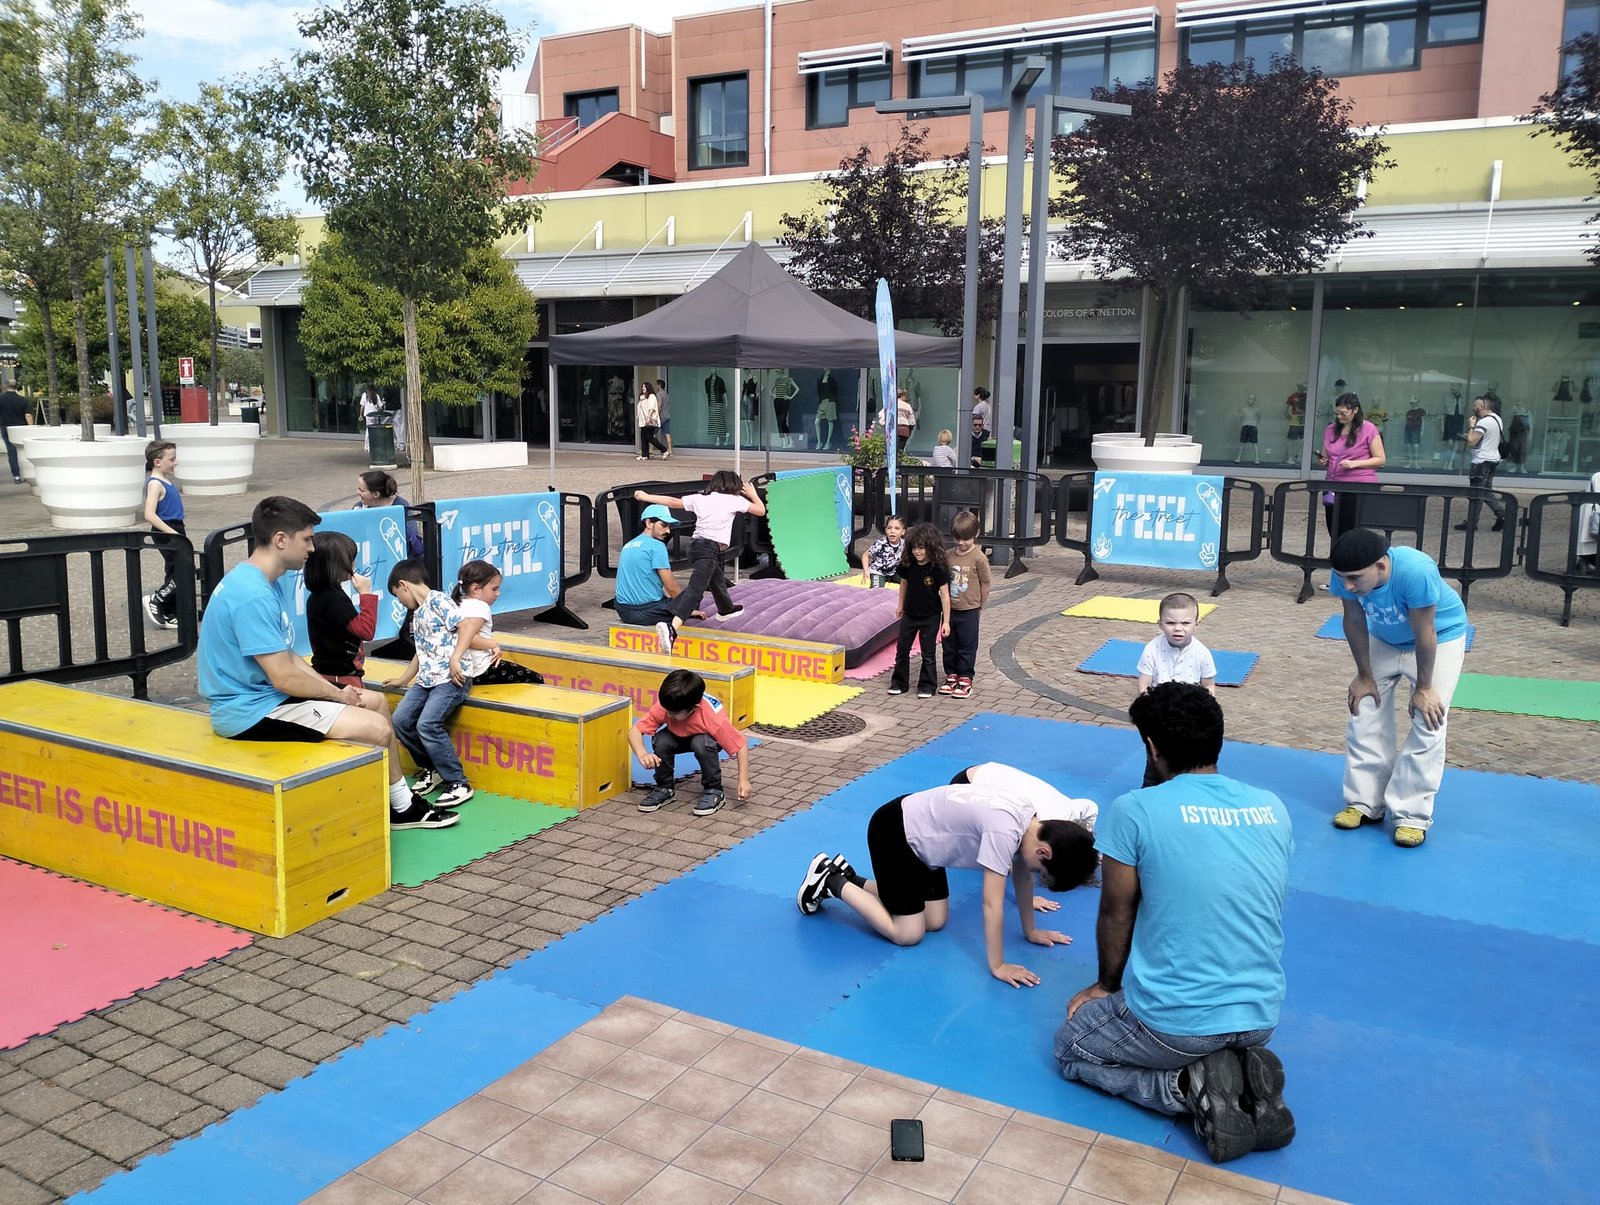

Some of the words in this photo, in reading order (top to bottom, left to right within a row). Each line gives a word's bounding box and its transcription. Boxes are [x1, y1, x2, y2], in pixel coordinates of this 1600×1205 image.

[1075, 308, 1087, 317] OF
[1112, 505, 1145, 526] the
[1149, 508, 1200, 530] street
[1114, 494, 1196, 541] FEEL
[458, 541, 493, 561] the
[496, 533, 544, 564] street
[699, 641, 720, 661] IS
[727, 646, 827, 679] CULTURE
[455, 731, 555, 778] LTURE
[55, 784, 84, 825] IS
[93, 795, 238, 869] CULTURE
[1180, 805, 1278, 827] ISTRUTTORE
